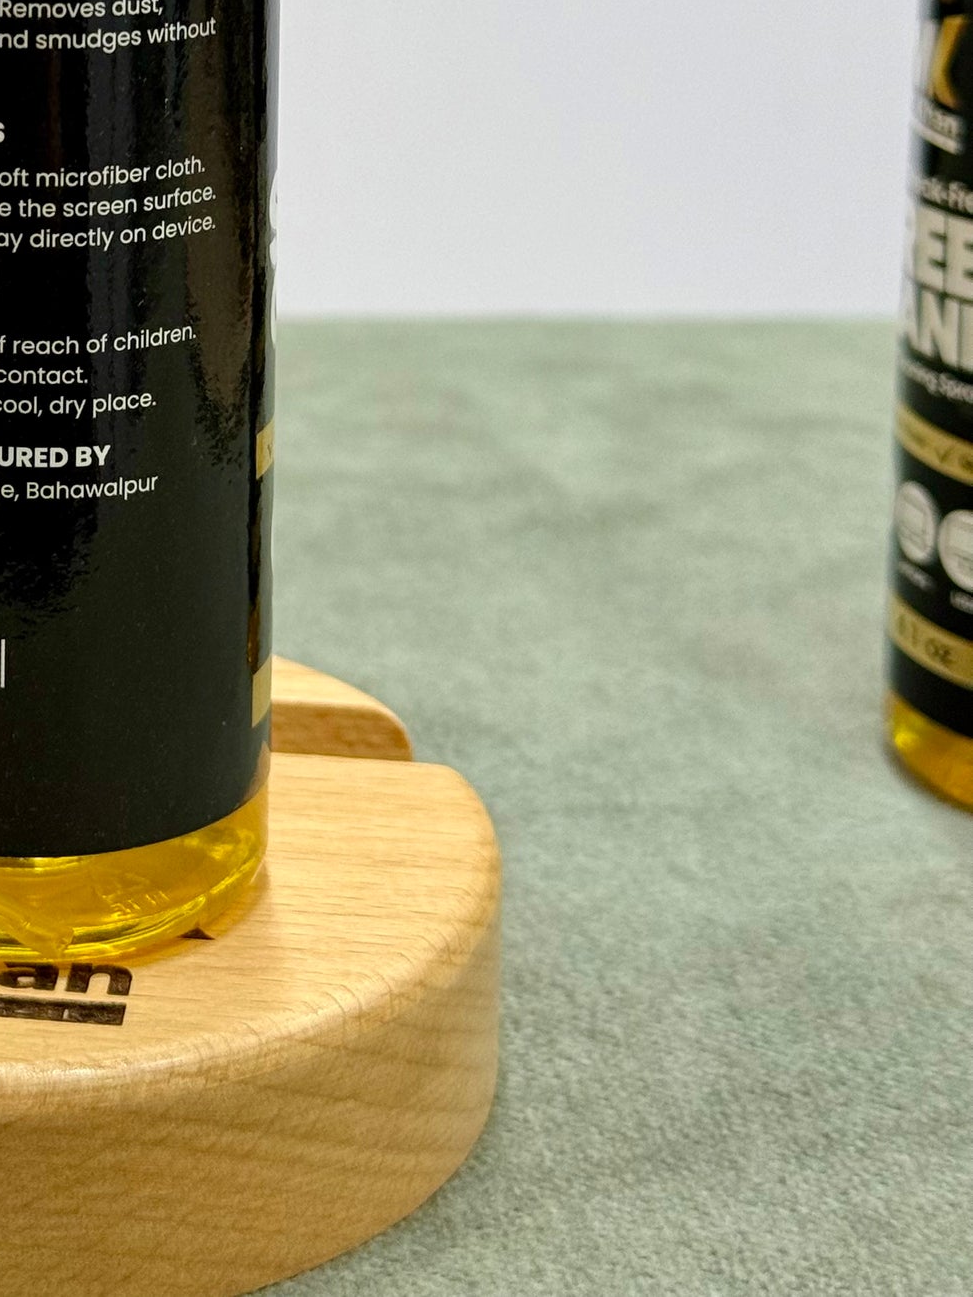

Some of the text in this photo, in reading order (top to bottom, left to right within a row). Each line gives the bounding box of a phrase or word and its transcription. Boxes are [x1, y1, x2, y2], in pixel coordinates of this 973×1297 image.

[35, 28, 142, 55] smudges
[146, 16, 217, 45] without
[35, 164, 151, 189] microfiber
[155, 155, 206, 180] cloth.
[17, 198, 57, 218] the
[62, 198, 138, 218] screen
[142, 185, 217, 212] surface.
[29, 226, 115, 252] directly
[119, 227, 147, 245] on
[151, 215, 216, 241] device.
[12, 335, 80, 355] reach
[85, 332, 108, 354] of
[113, 325, 197, 352] children.
[48, 395, 87, 420] dry
[92, 392, 157, 419] place.
[75, 444, 112, 468] BY
[26, 475, 159, 501] Bahawalpur
